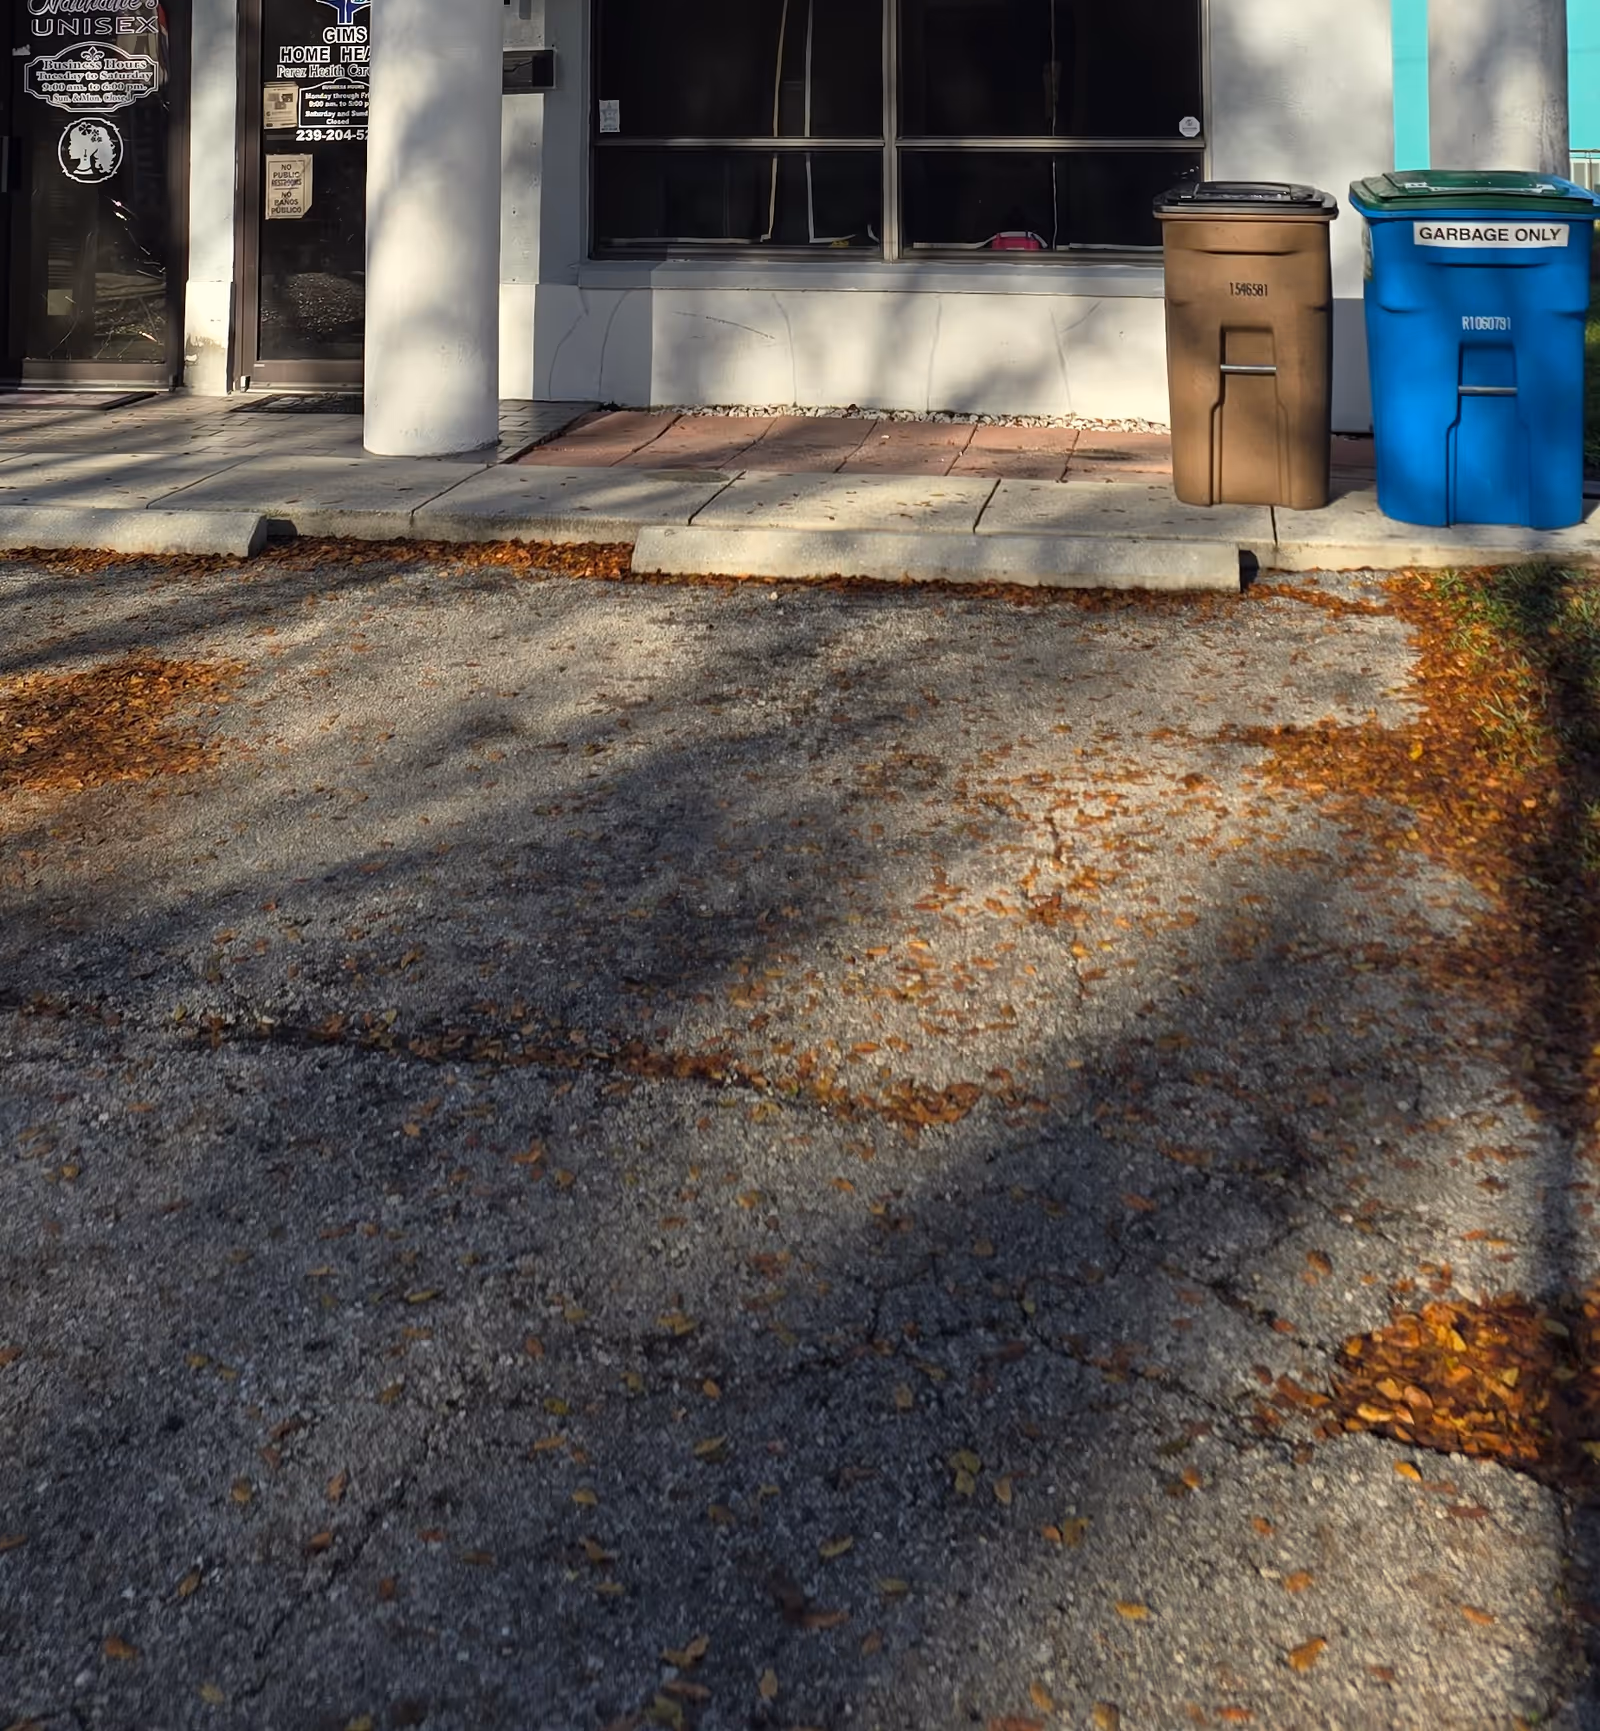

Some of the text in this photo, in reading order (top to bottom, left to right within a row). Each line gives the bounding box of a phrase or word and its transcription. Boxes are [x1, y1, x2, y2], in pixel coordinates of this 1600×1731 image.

[31, 16, 159, 37] UNISEX
[322, 26, 367, 44] GIMS
[279, 46, 331, 63] HOME
[42, 58, 147, 71] Business Hours
[276, 64, 307, 78] Perez
[308, 64, 345, 78] Health
[36, 71, 153, 83] Tuesday to Saturday
[41, 82, 66, 92] 9:00
[88, 83, 100, 92] to
[101, 82, 125, 92] 6:00
[305, 92, 332, 100] Monday
[333, 92, 359, 100] through
[305, 110, 336, 118] Saturday
[272, 171, 300, 179] PUBLIC
[1419, 227, 1562, 242] GARBAGE ONLY
